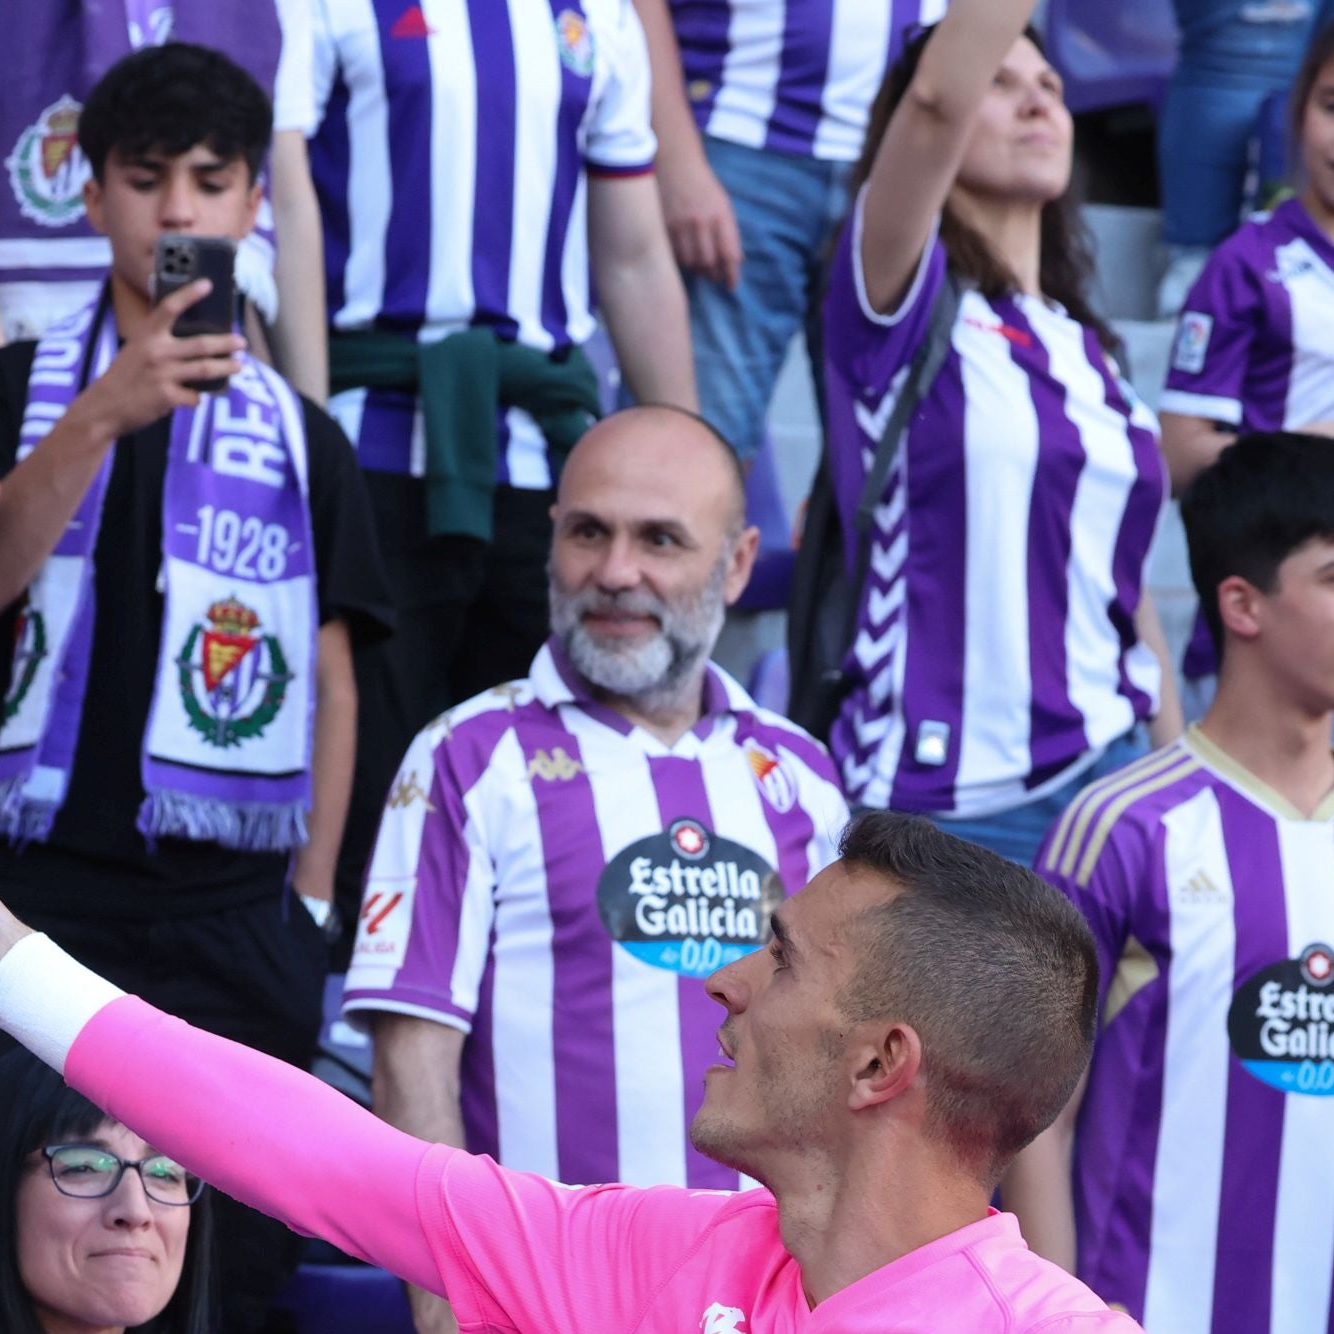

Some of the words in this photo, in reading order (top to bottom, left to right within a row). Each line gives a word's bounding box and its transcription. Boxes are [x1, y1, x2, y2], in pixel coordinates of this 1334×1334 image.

[197, 504, 289, 580] 1928
[628, 855, 762, 900] Estrella
[635, 895, 760, 939] Galicia
